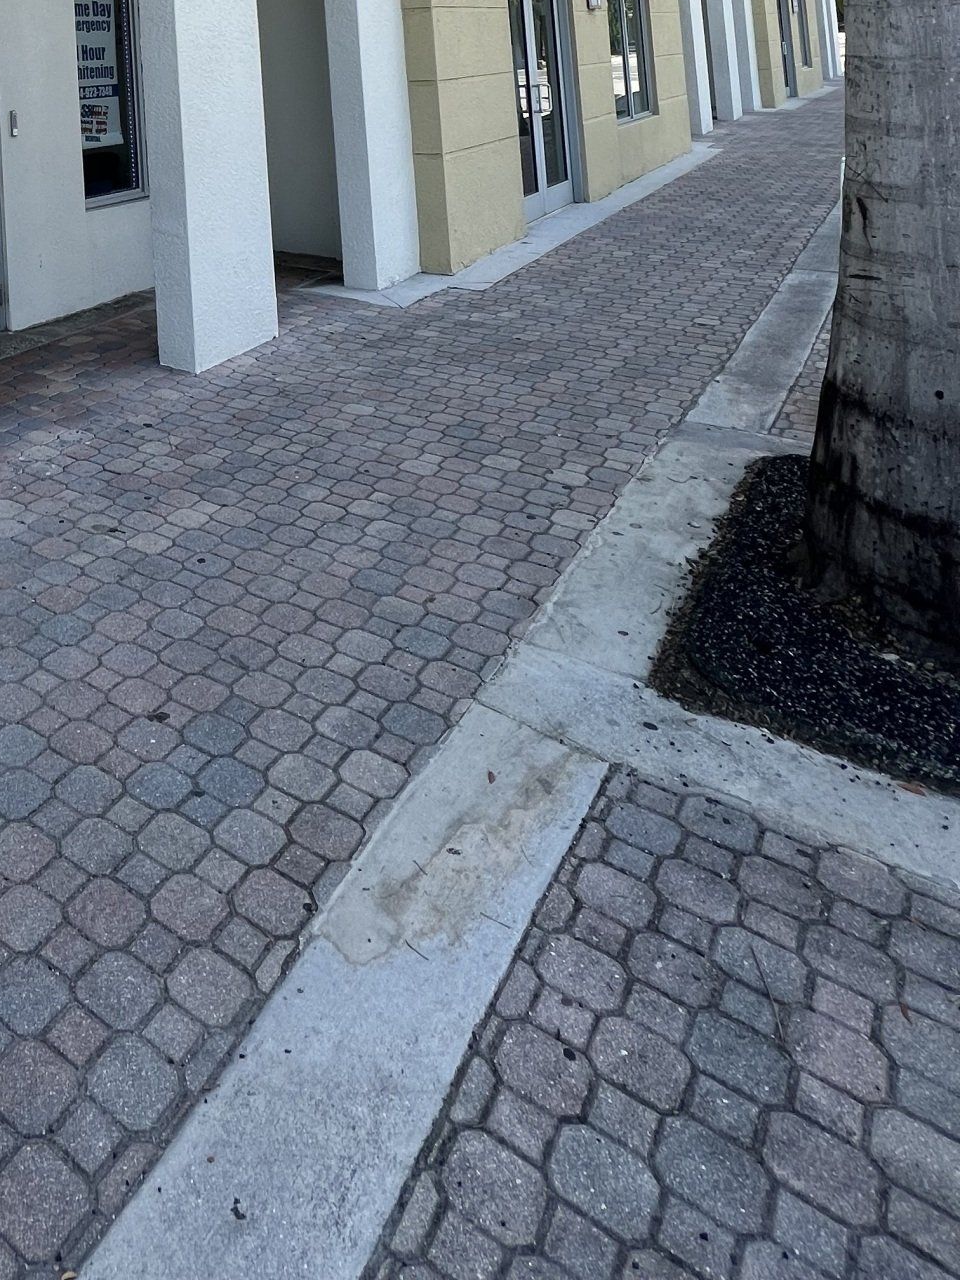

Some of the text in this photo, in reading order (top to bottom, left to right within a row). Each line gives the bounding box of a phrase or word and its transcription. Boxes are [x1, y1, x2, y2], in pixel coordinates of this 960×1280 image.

[92, 0, 111, 18] Day
[76, 20, 110, 33] ergency
[81, 45, 105, 61] Hour
[78, 64, 114, 80] hitening
